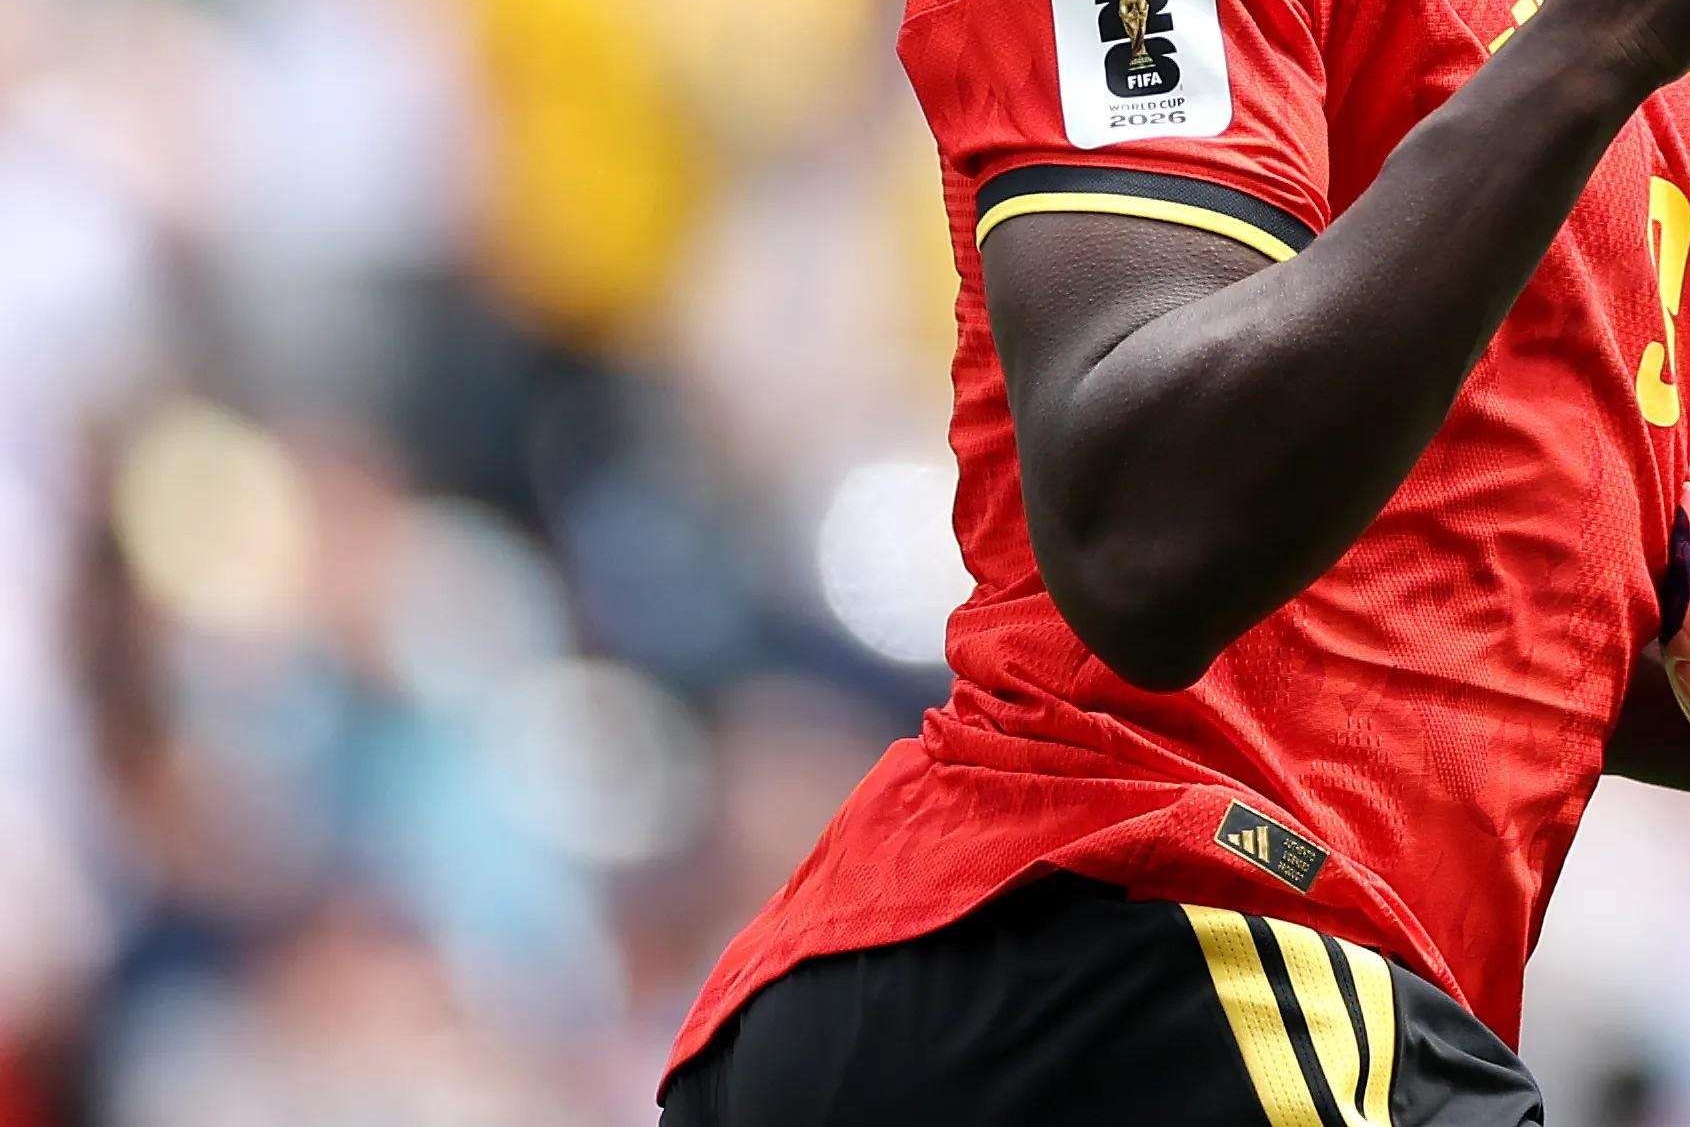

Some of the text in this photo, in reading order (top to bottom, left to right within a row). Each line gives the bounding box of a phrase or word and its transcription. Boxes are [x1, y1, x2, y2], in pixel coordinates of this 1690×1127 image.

[1127, 72, 1163, 89] FIFA
[1109, 97, 1185, 111] WORLD CUP
[1109, 111, 1186, 127] 2026
